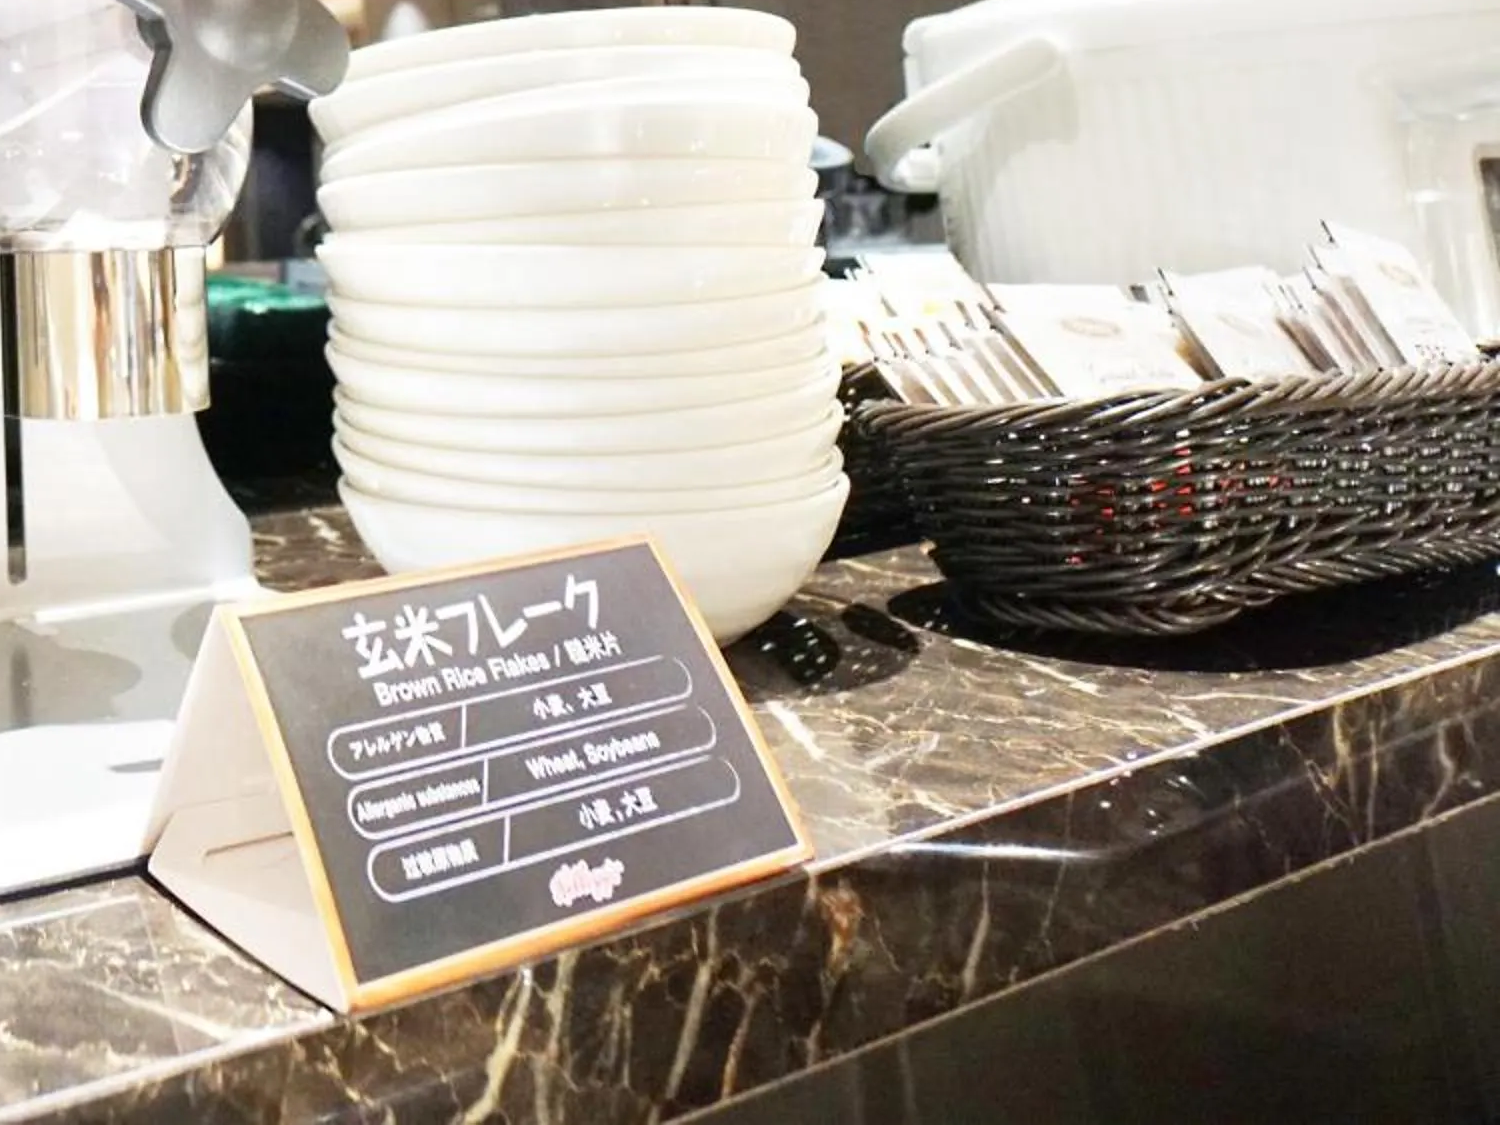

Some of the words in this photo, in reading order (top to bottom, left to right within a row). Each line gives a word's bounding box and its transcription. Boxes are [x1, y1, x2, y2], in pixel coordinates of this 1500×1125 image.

[342, 574, 599, 679] 玄米フレーク
[373, 675, 442, 707] Brown
[442, 664, 487, 691] Rice
[487, 651, 550, 681] Flakes
